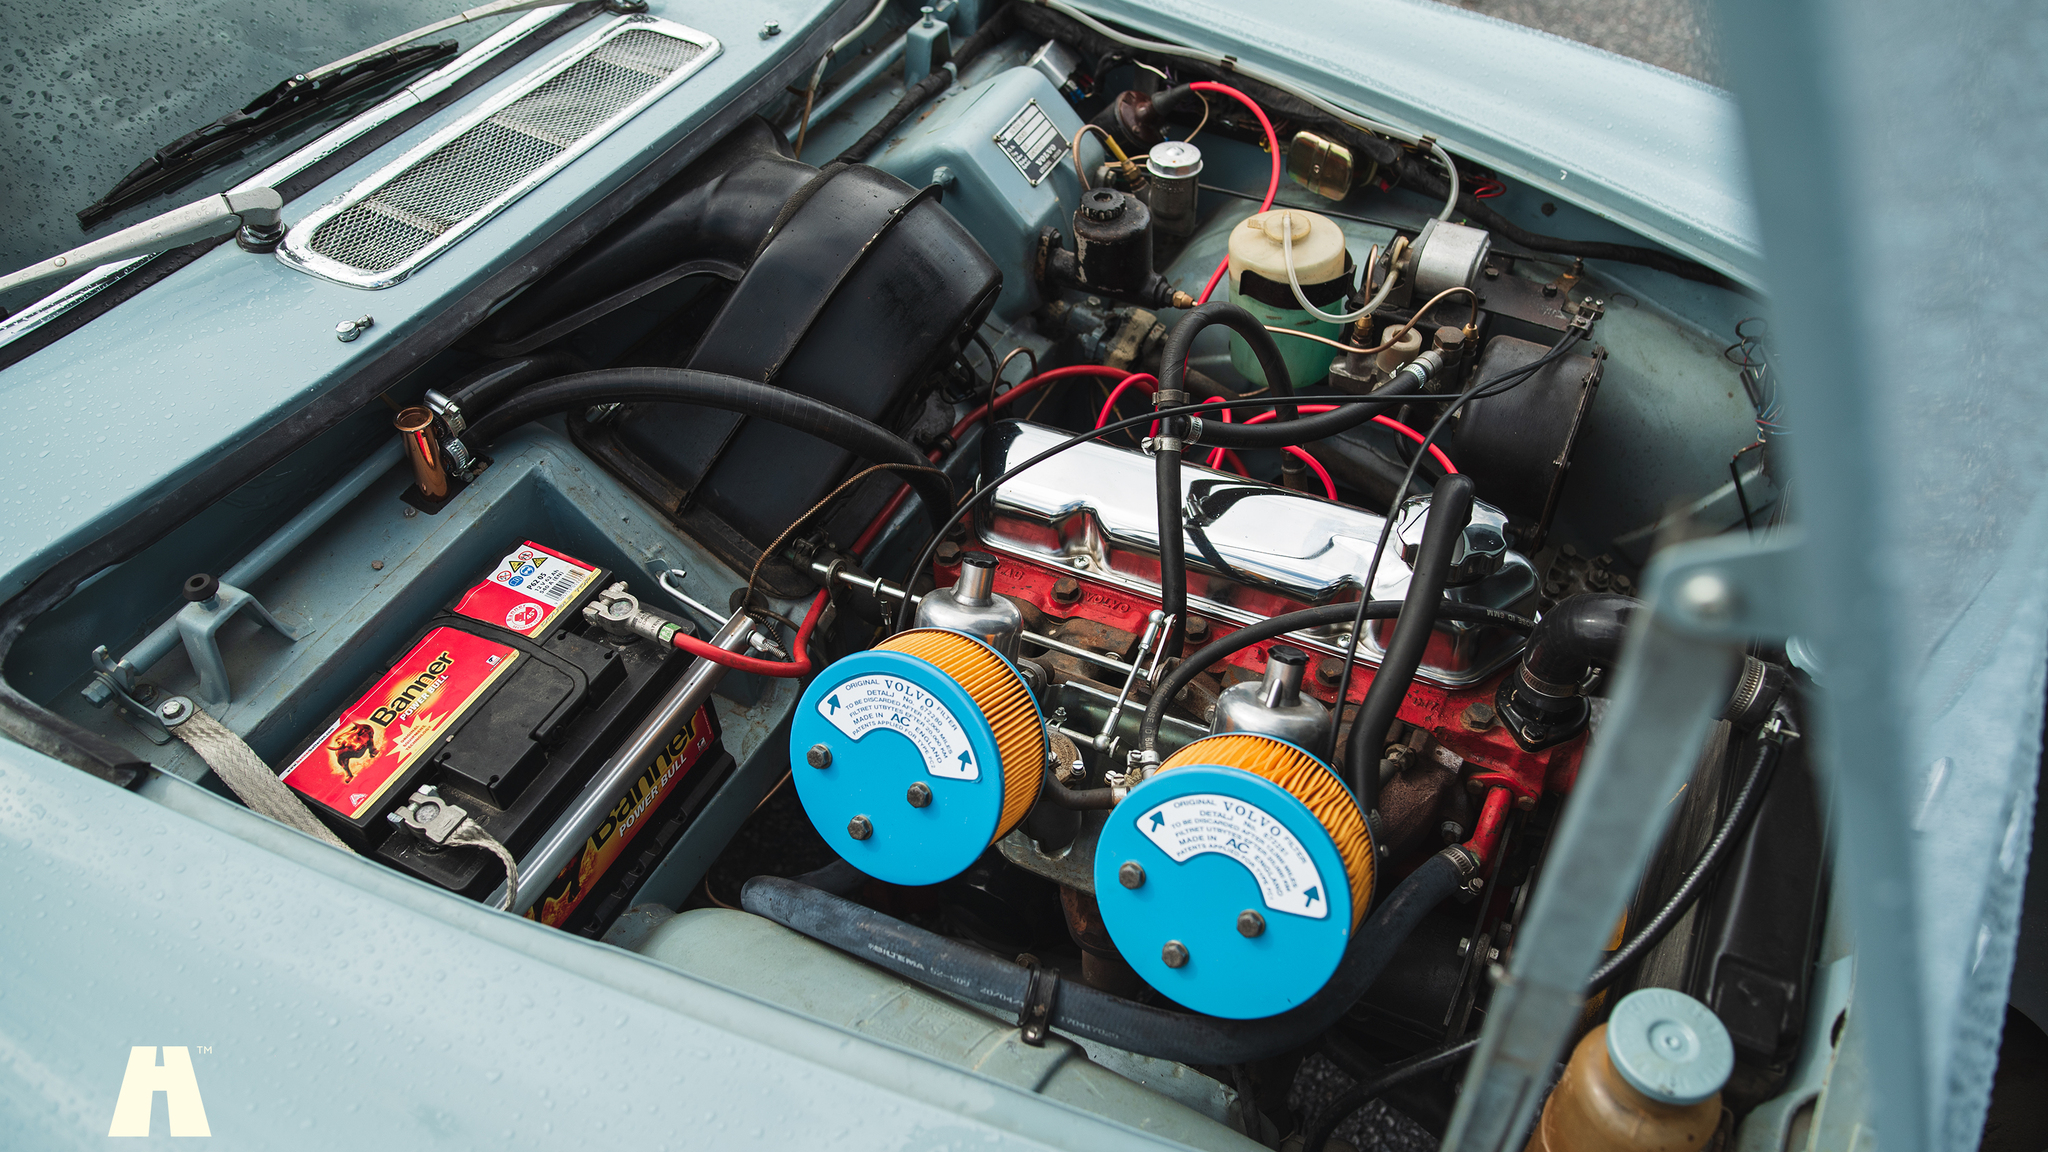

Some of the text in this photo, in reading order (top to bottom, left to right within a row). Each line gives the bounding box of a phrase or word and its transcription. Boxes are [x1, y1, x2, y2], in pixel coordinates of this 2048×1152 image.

[1035, 144, 1057, 166] VOLVO
[526, 578, 540, 590] P62
[1086, 592, 1131, 613] VOLVO
[370, 652, 453, 728] Banner
[400, 674, 450, 721] POWER BULL
[845, 679, 958, 731] ORIGINAL VOLVO FILTER
[1157, 679, 1174, 697] FUEL
[849, 705, 872, 718] FILTRET
[874, 705, 903, 714] UTBYTES
[905, 712, 925, 727] EFTER
[941, 748, 948, 758] KM
[864, 697, 900, 706] DISCARDED
[902, 704, 922, 717] AFTER
[940, 734, 952, 754] MILES
[1145, 726, 1152, 734] ID
[1147, 701, 1160, 723] HOSE
[852, 720, 876, 735] PATENTS
[878, 720, 903, 731] APPLIED
[905, 728, 917, 739] FOR
[918, 740, 929, 754] TYPE
[853, 713, 874, 725] MADE
[890, 713, 910, 727] AC
[915, 727, 942, 764] ENGLAND
[591, 712, 698, 850] Banner
[619, 754, 687, 837] POWER BULL
[1173, 799, 1216, 808] ORIGINAL
[1223, 801, 1281, 836] VOLVO
[1179, 836, 1204, 845] MADE
[1226, 838, 1250, 854] AC
[1255, 855, 1283, 896] ENGLAND
[872, 944, 925, 971] BILTEMA
